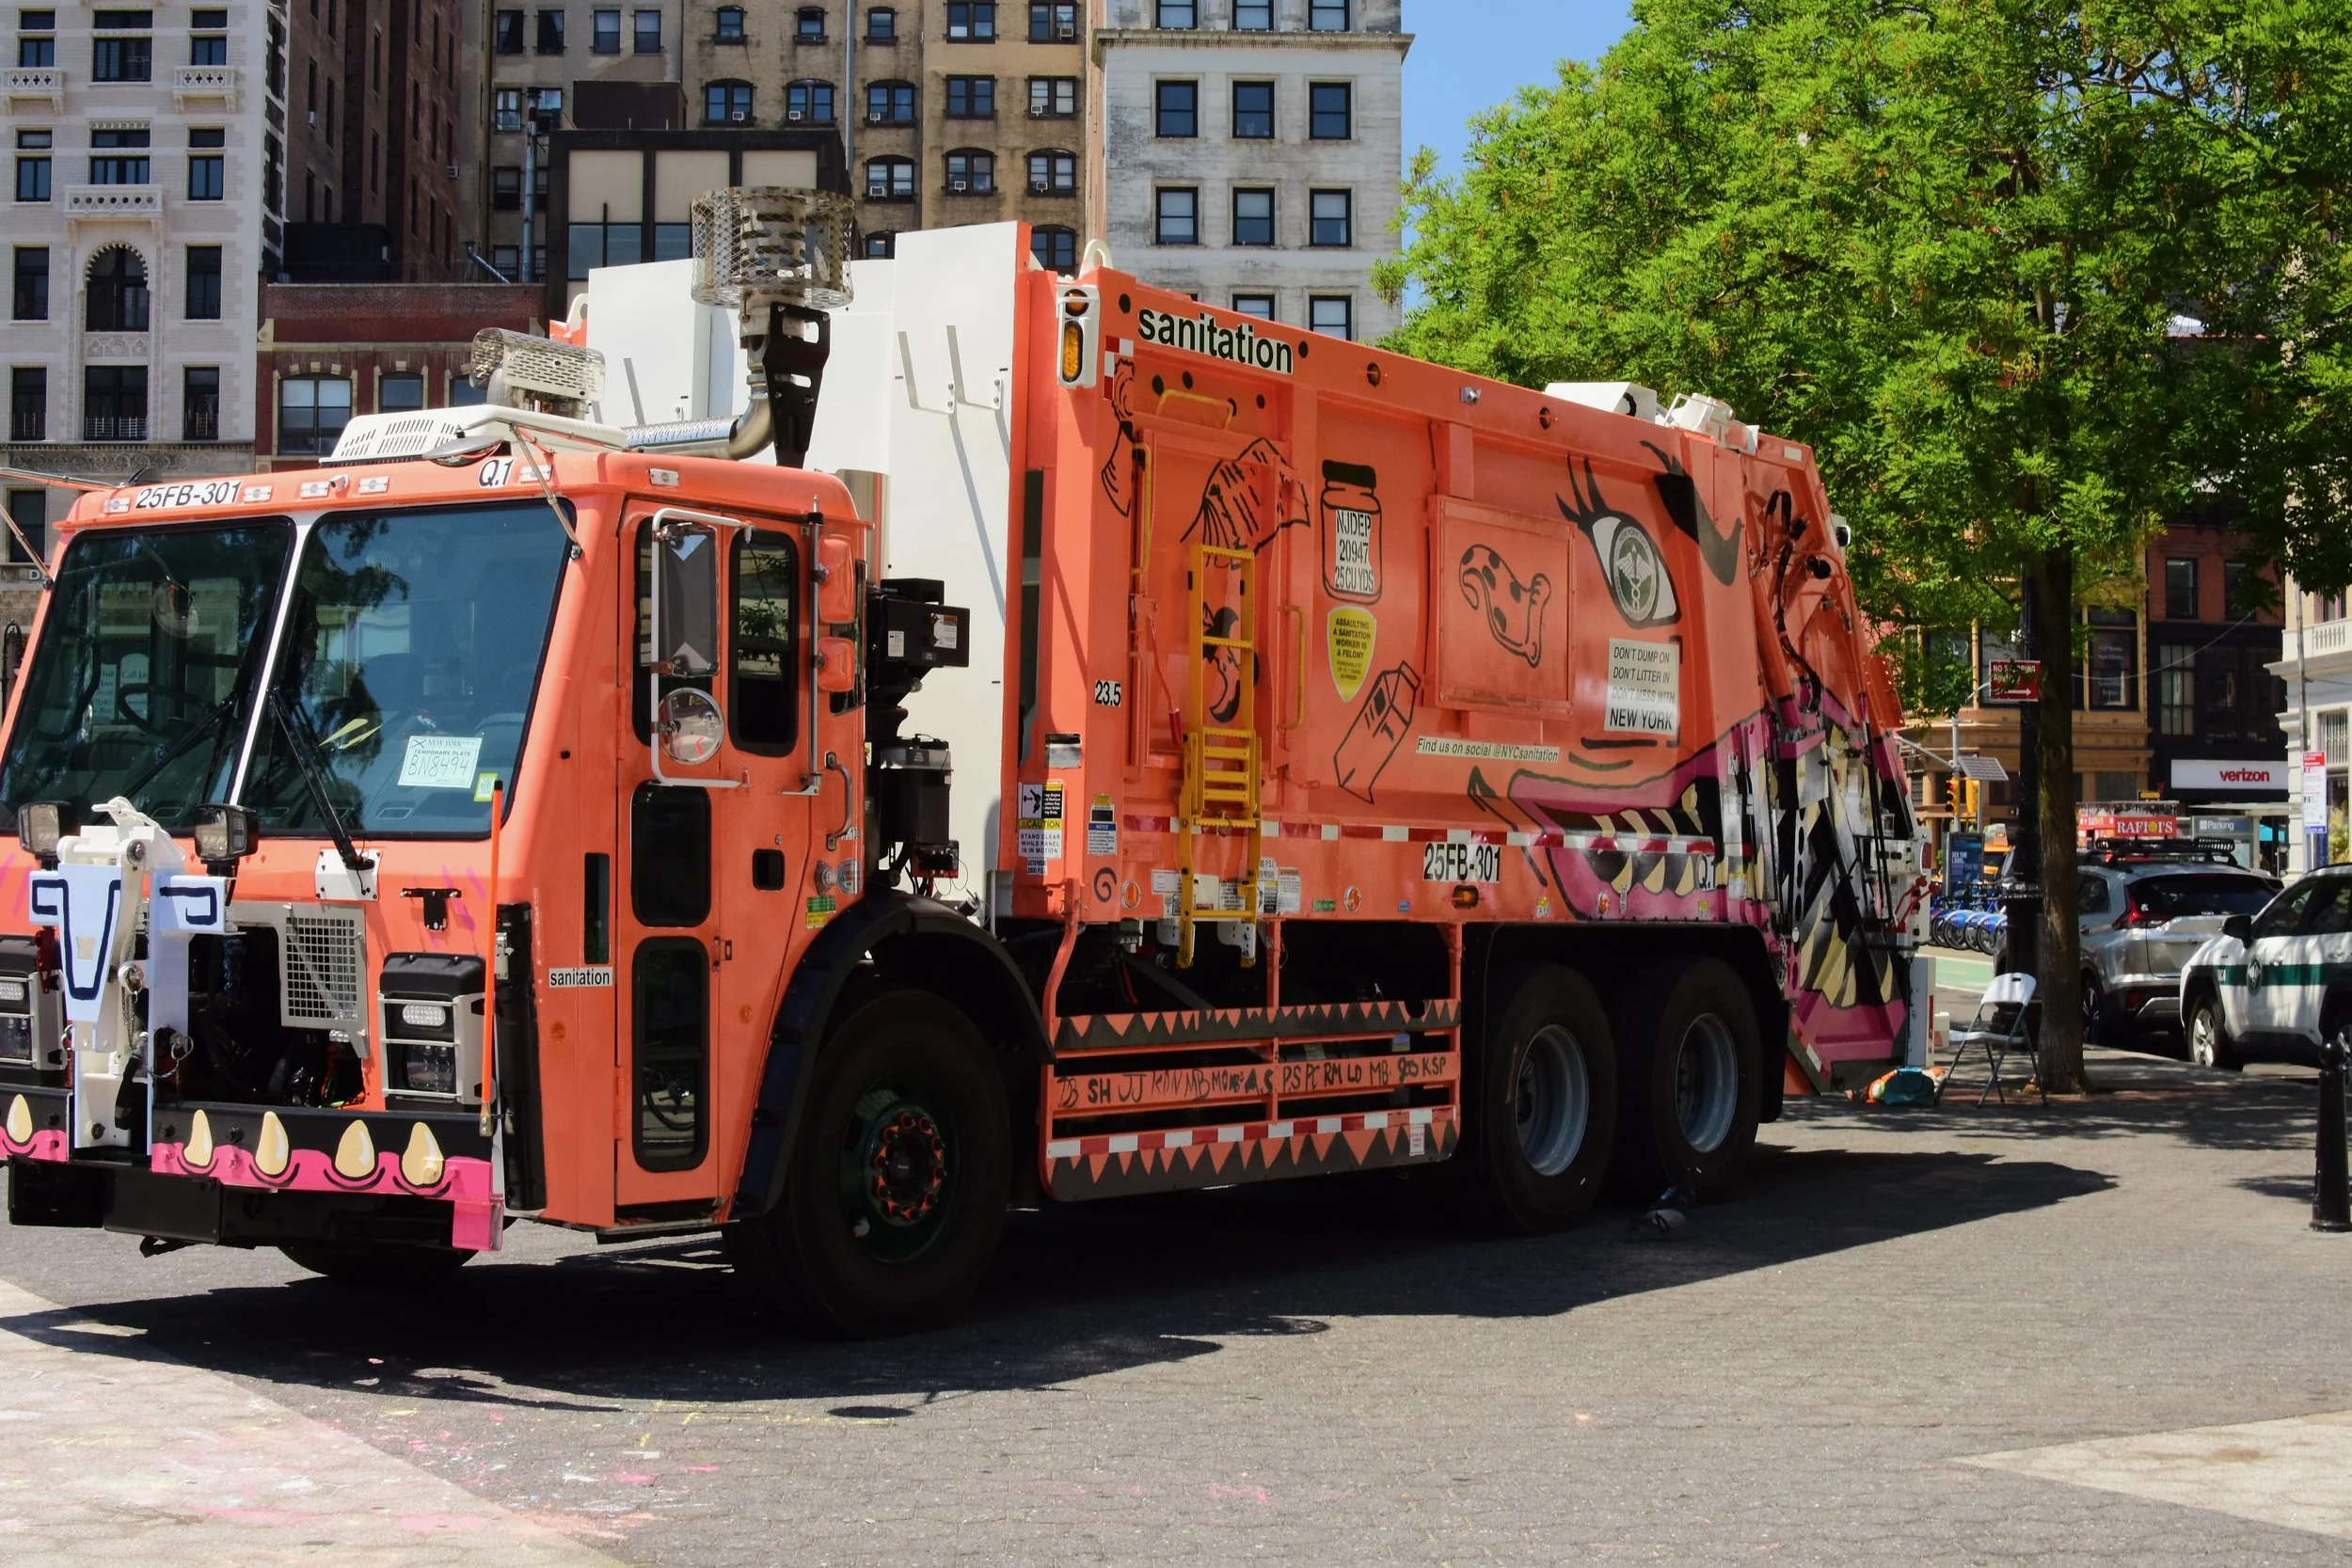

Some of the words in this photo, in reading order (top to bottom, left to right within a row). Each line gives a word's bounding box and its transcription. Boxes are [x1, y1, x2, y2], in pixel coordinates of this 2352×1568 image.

[1138, 309, 1292, 373] sanitation
[479, 459, 515, 487] Q.1
[135, 481, 242, 509] 25FB-301
[1337, 510, 1371, 537] NJDEP
[1340, 539, 1369, 564] 20947
[1335, 566, 1344, 589] 25
[1345, 567, 1357, 590] CU
[1359, 568, 1374, 593] YDS
[1336, 618, 1370, 629] ASSAULTING
[1338, 628, 1371, 640] SANITATION
[1336, 639, 1360, 649] WORKER
[1361, 641, 1367, 650] IS
[1343, 649, 1364, 659] FELONY
[1613, 646, 1636, 661] DON'T
[1638, 649, 1659, 663] DUMP
[1660, 651, 1670, 664] ON
[1613, 667, 1636, 680] DON'T
[1637, 669, 1661, 683] LITTER
[1661, 671, 1671, 684] IN
[1993, 664, 2002, 673] NO
[1095, 680, 1121, 706] 23.5
[1612, 687, 1635, 700] DON'T
[1636, 689, 1656, 703] MESS
[1657, 690, 1676, 705] WITH
[1610, 707, 1638, 728] NEW
[1641, 709, 1673, 730] YORK
[1417, 737, 1438, 752] Find
[1438, 742, 1450, 753] us
[1452, 743, 1463, 754] on
[1465, 744, 1491, 756] social
[1493, 744, 1558, 762] @NYCsanitation
[407, 754, 469, 777] BN8494
[2219, 768, 2270, 782] verizon
[1026, 819, 1060, 829] CAUTION
[2208, 820, 2234, 832] Parking
[1423, 843, 1502, 882] 25FB-301
[1696, 854, 1717, 890] Q.1
[550, 968, 610, 986] sanitation
[1088, 1077, 1111, 1103] SH
[1324, 1062, 1343, 1085] RM
[1347, 1062, 1362, 1084] LD
[1422, 1056, 1446, 1077] KSP
